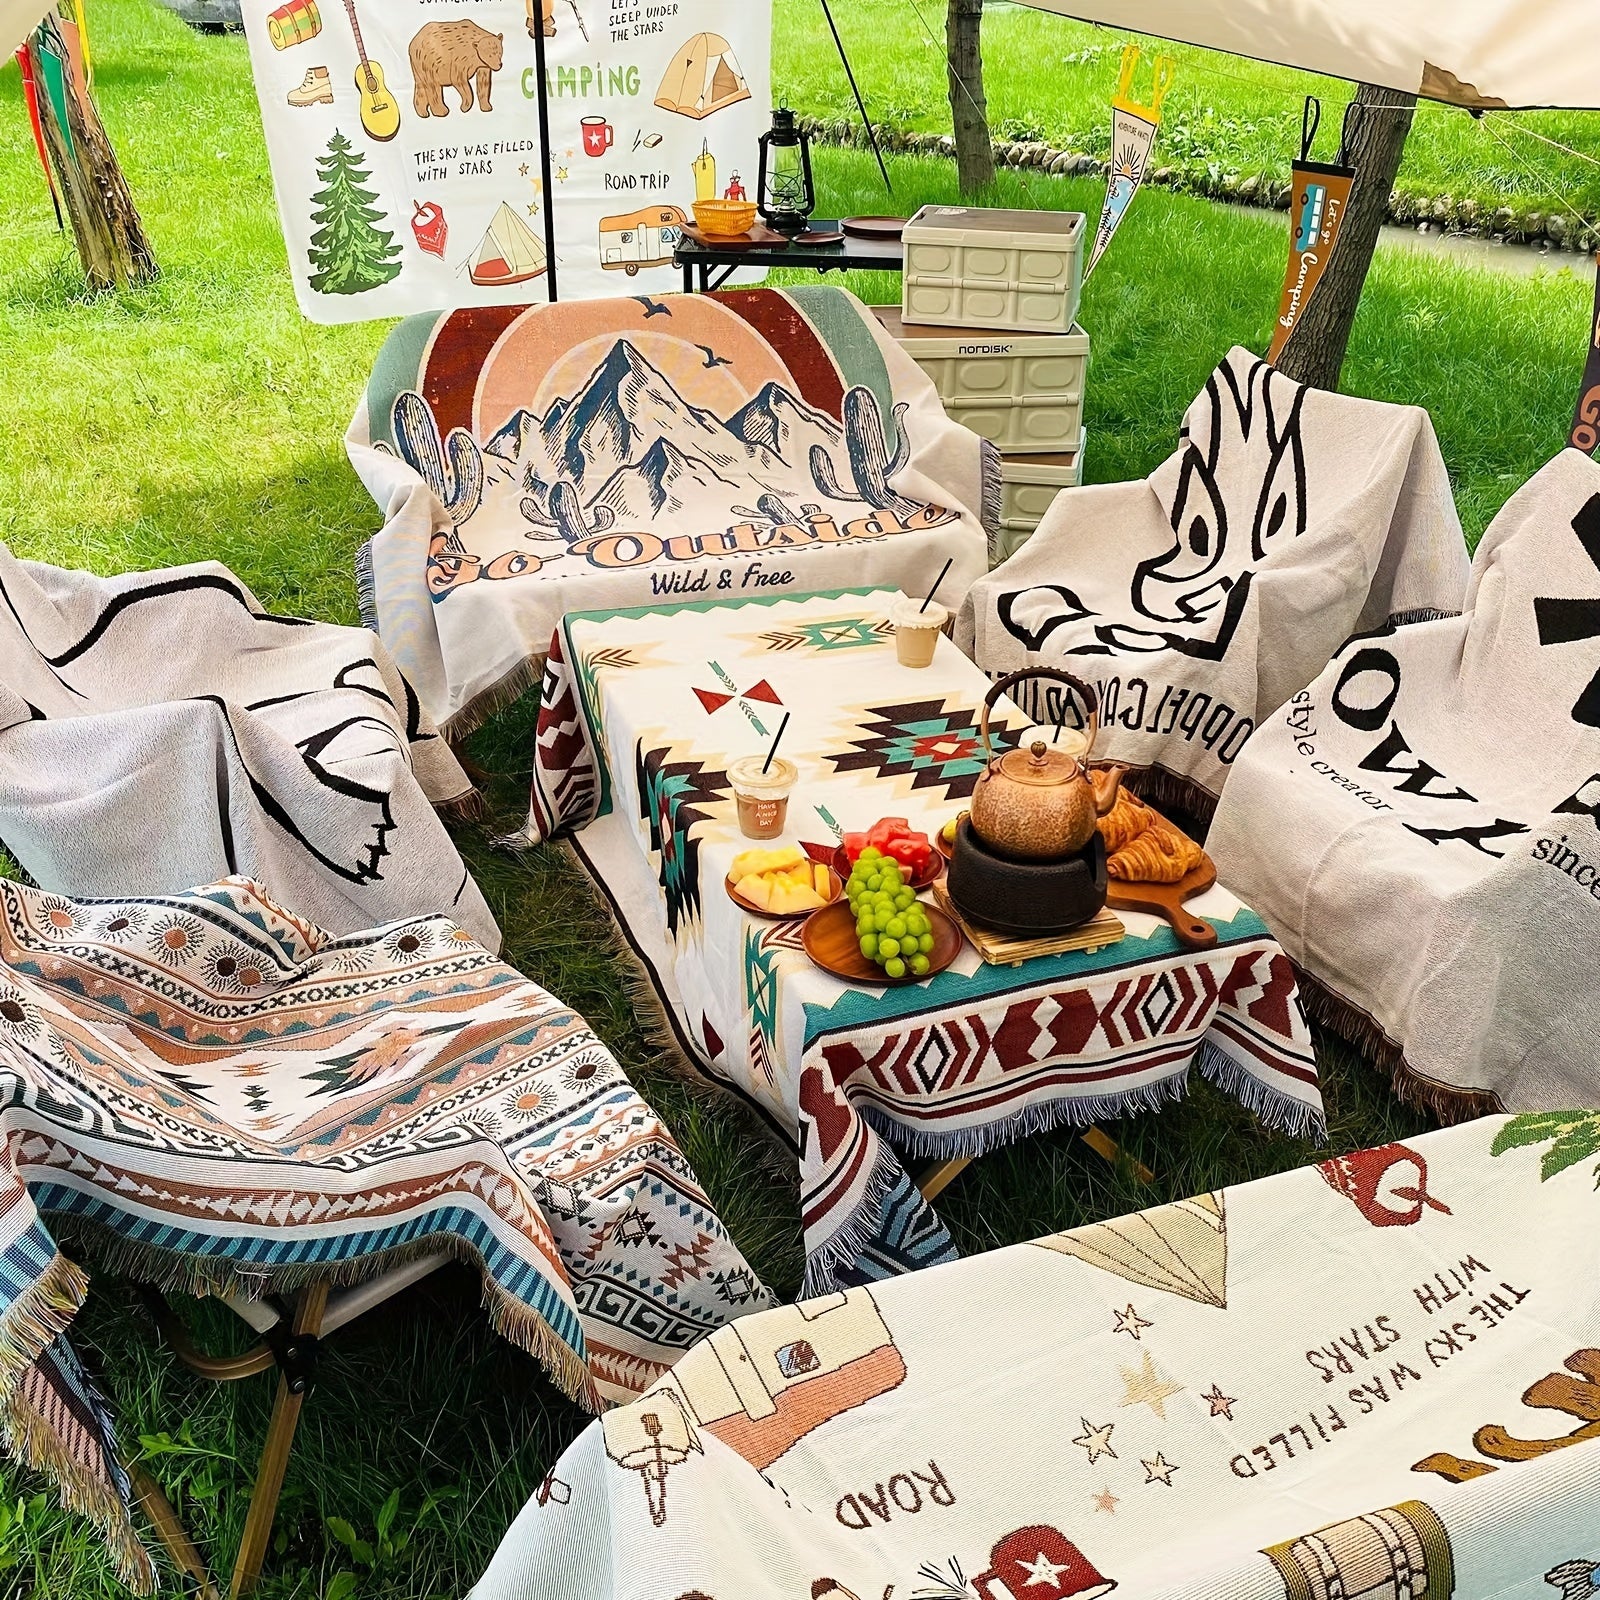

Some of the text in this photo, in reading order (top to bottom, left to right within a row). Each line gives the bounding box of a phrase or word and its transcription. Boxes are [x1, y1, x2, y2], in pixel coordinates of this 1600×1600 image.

[608, 3, 679, 27] SLEEP UNDER
[610, 21, 664, 43] THE STARS
[414, 140, 534, 166] THE SKY WAS FILLED
[417, 159, 493, 183] WITH STARS
[604, 170, 670, 191] ROAD TRIP
[1279, 250, 1319, 329] Camping
[565, 502, 962, 568] Outside
[650, 561, 796, 595] Wild & Free
[1310, 760, 1394, 811] creator
[757, 802, 777, 810] HAVE
[759, 819, 774, 827] DAY
[1305, 1254, 1492, 1384] WITH STARS
[1229, 1281, 1532, 1479] THE SKY WAS FILLED
[835, 1458, 957, 1530] ROAD
